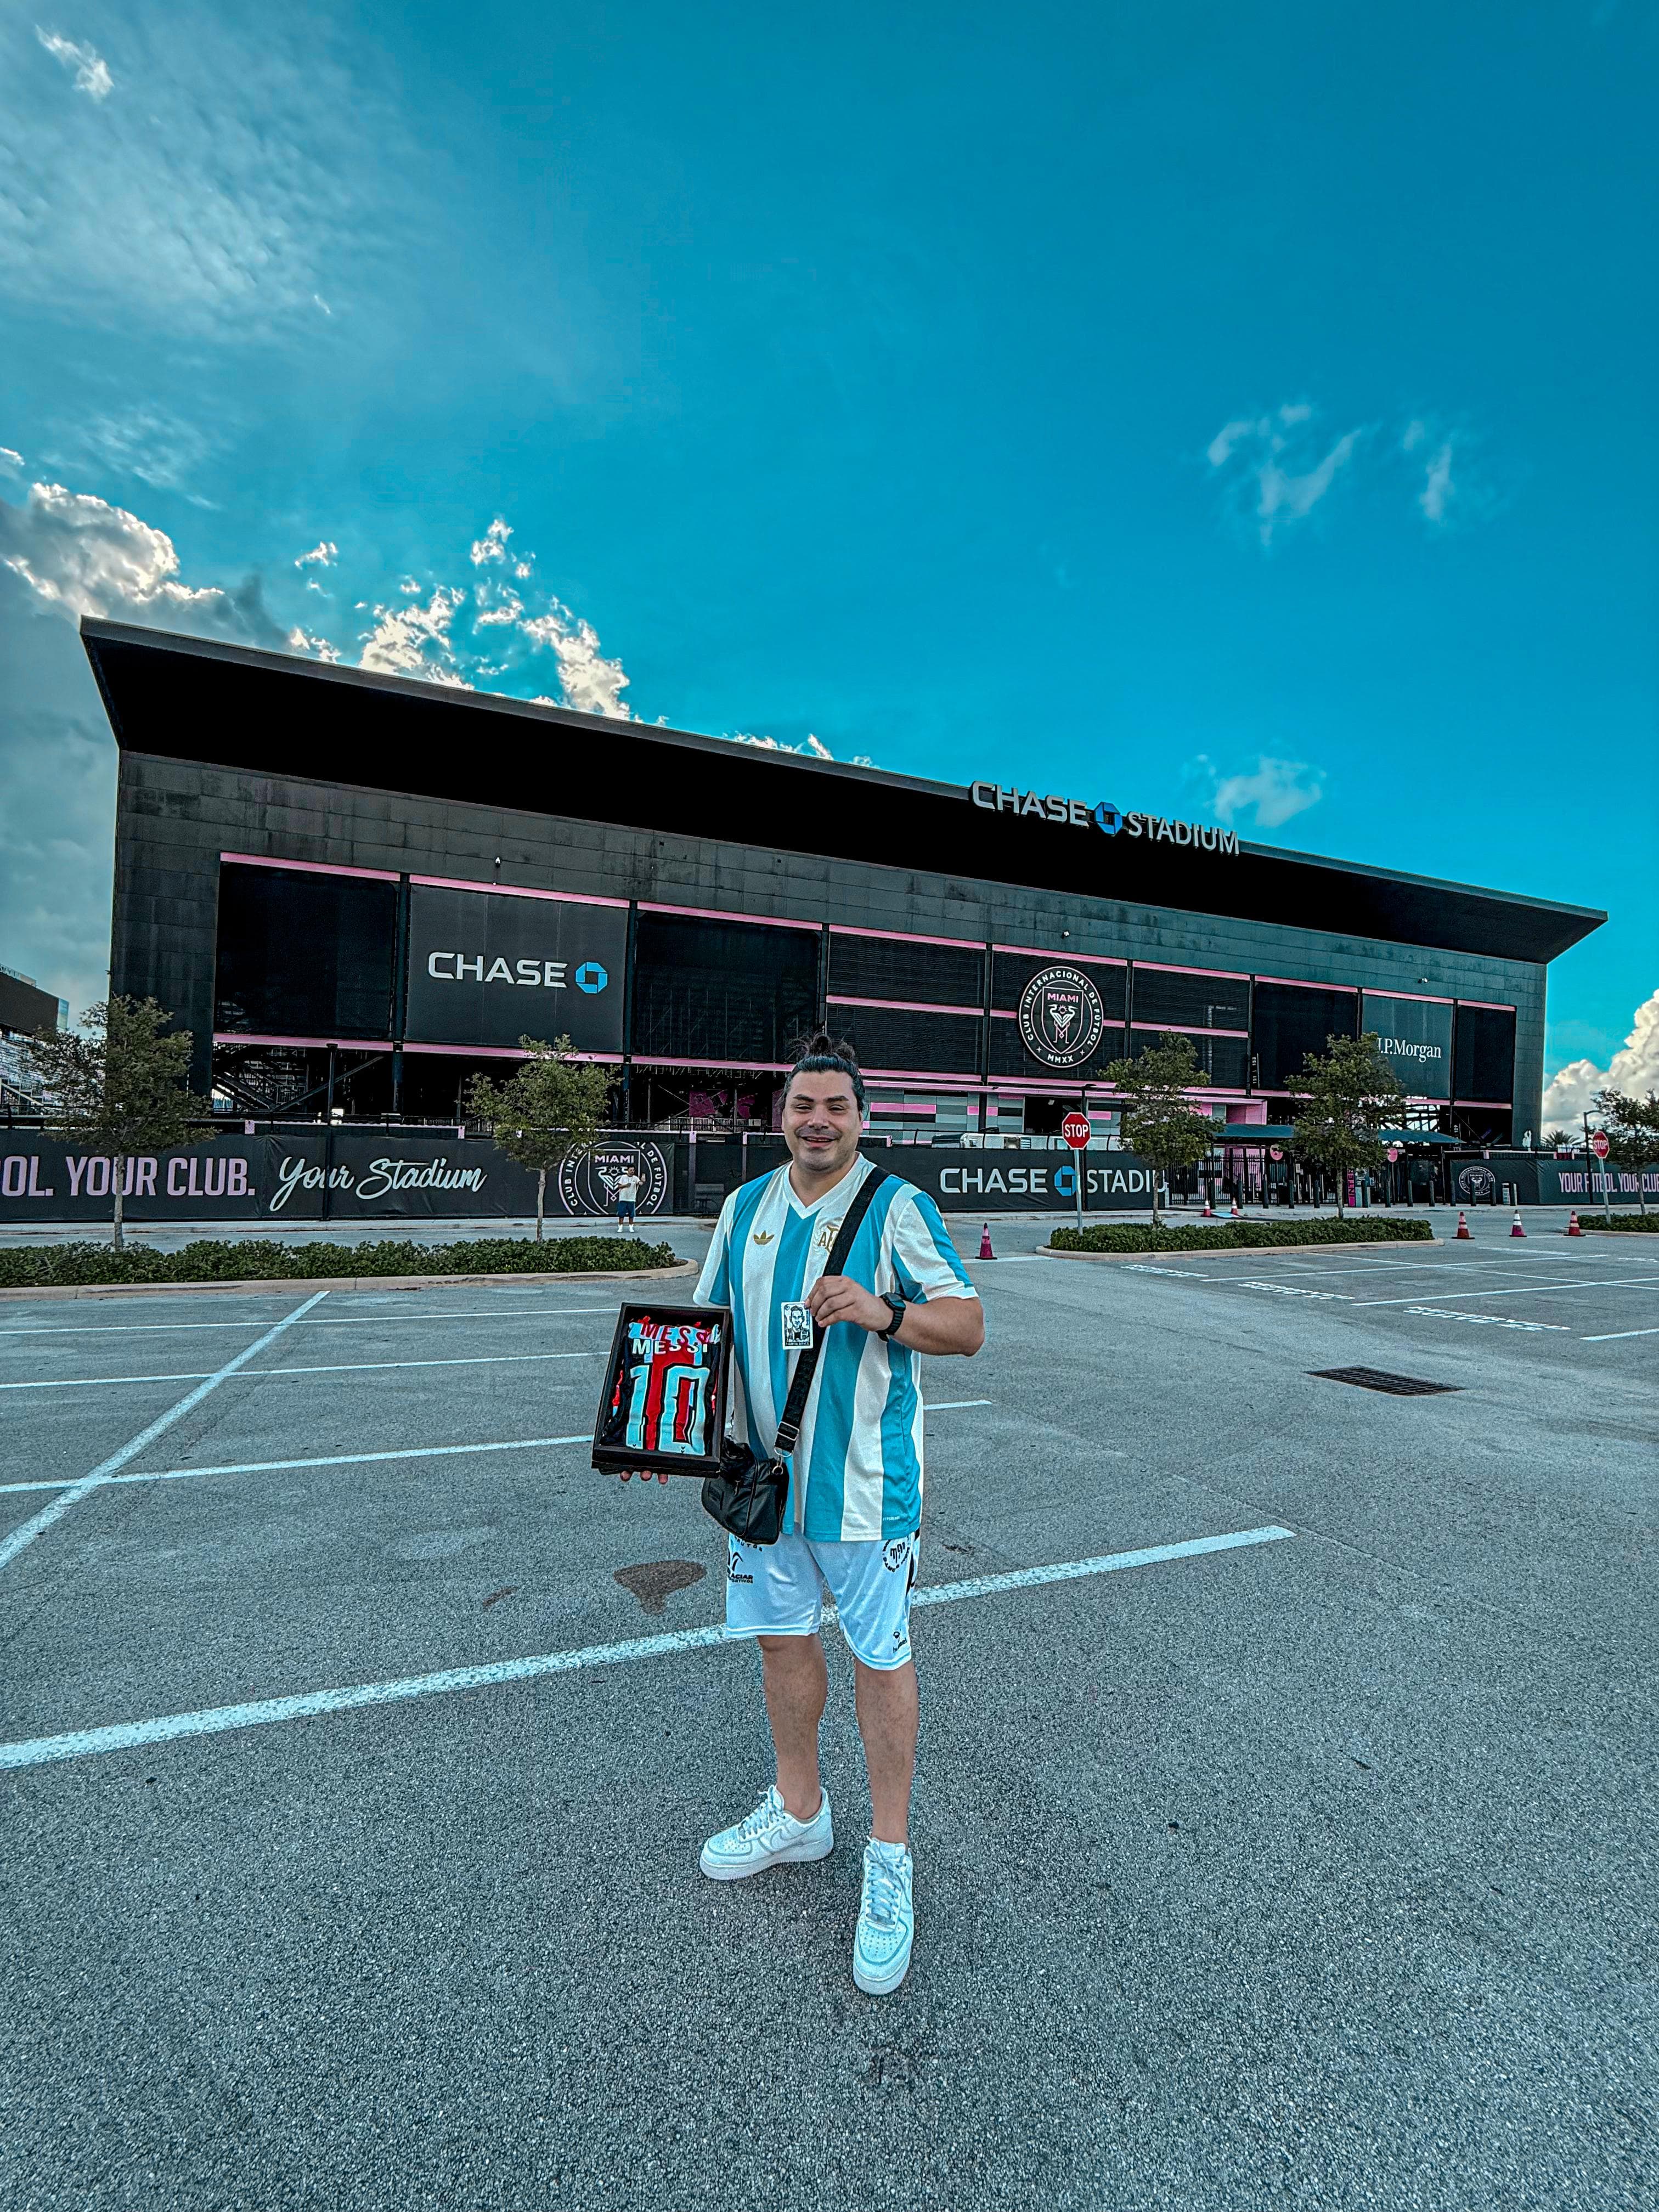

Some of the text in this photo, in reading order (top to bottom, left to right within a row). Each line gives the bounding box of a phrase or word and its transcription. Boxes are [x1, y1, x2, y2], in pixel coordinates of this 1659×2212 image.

[972, 781, 1239, 855] CHASE STADIUM
[428, 952, 568, 988] CHASE
[1024, 970, 1089, 1008] INTERNACIONAL
[1047, 993, 1079, 1003] MIAMI
[1088, 992, 1098, 1005] DE
[1023, 1014, 1034, 1041] CLUB
[1047, 1054, 1074, 1063] MMXX
[1064, 1124, 1088, 1138] STOP
[647, 1150, 658, 1163] DE
[1593, 1140, 1607, 1150] STOP
[595, 1155, 634, 1164] MIAMI
[0, 1155, 256, 1197] OL. YOUR CLUB.
[269, 1156, 488, 1212] Your Stadium
[940, 1168, 1048, 1193] CHASE
[1559, 1172, 1583, 1193] YOUR
[565, 1178, 578, 1206] CLUB
[626, 1364, 710, 1457] 10
